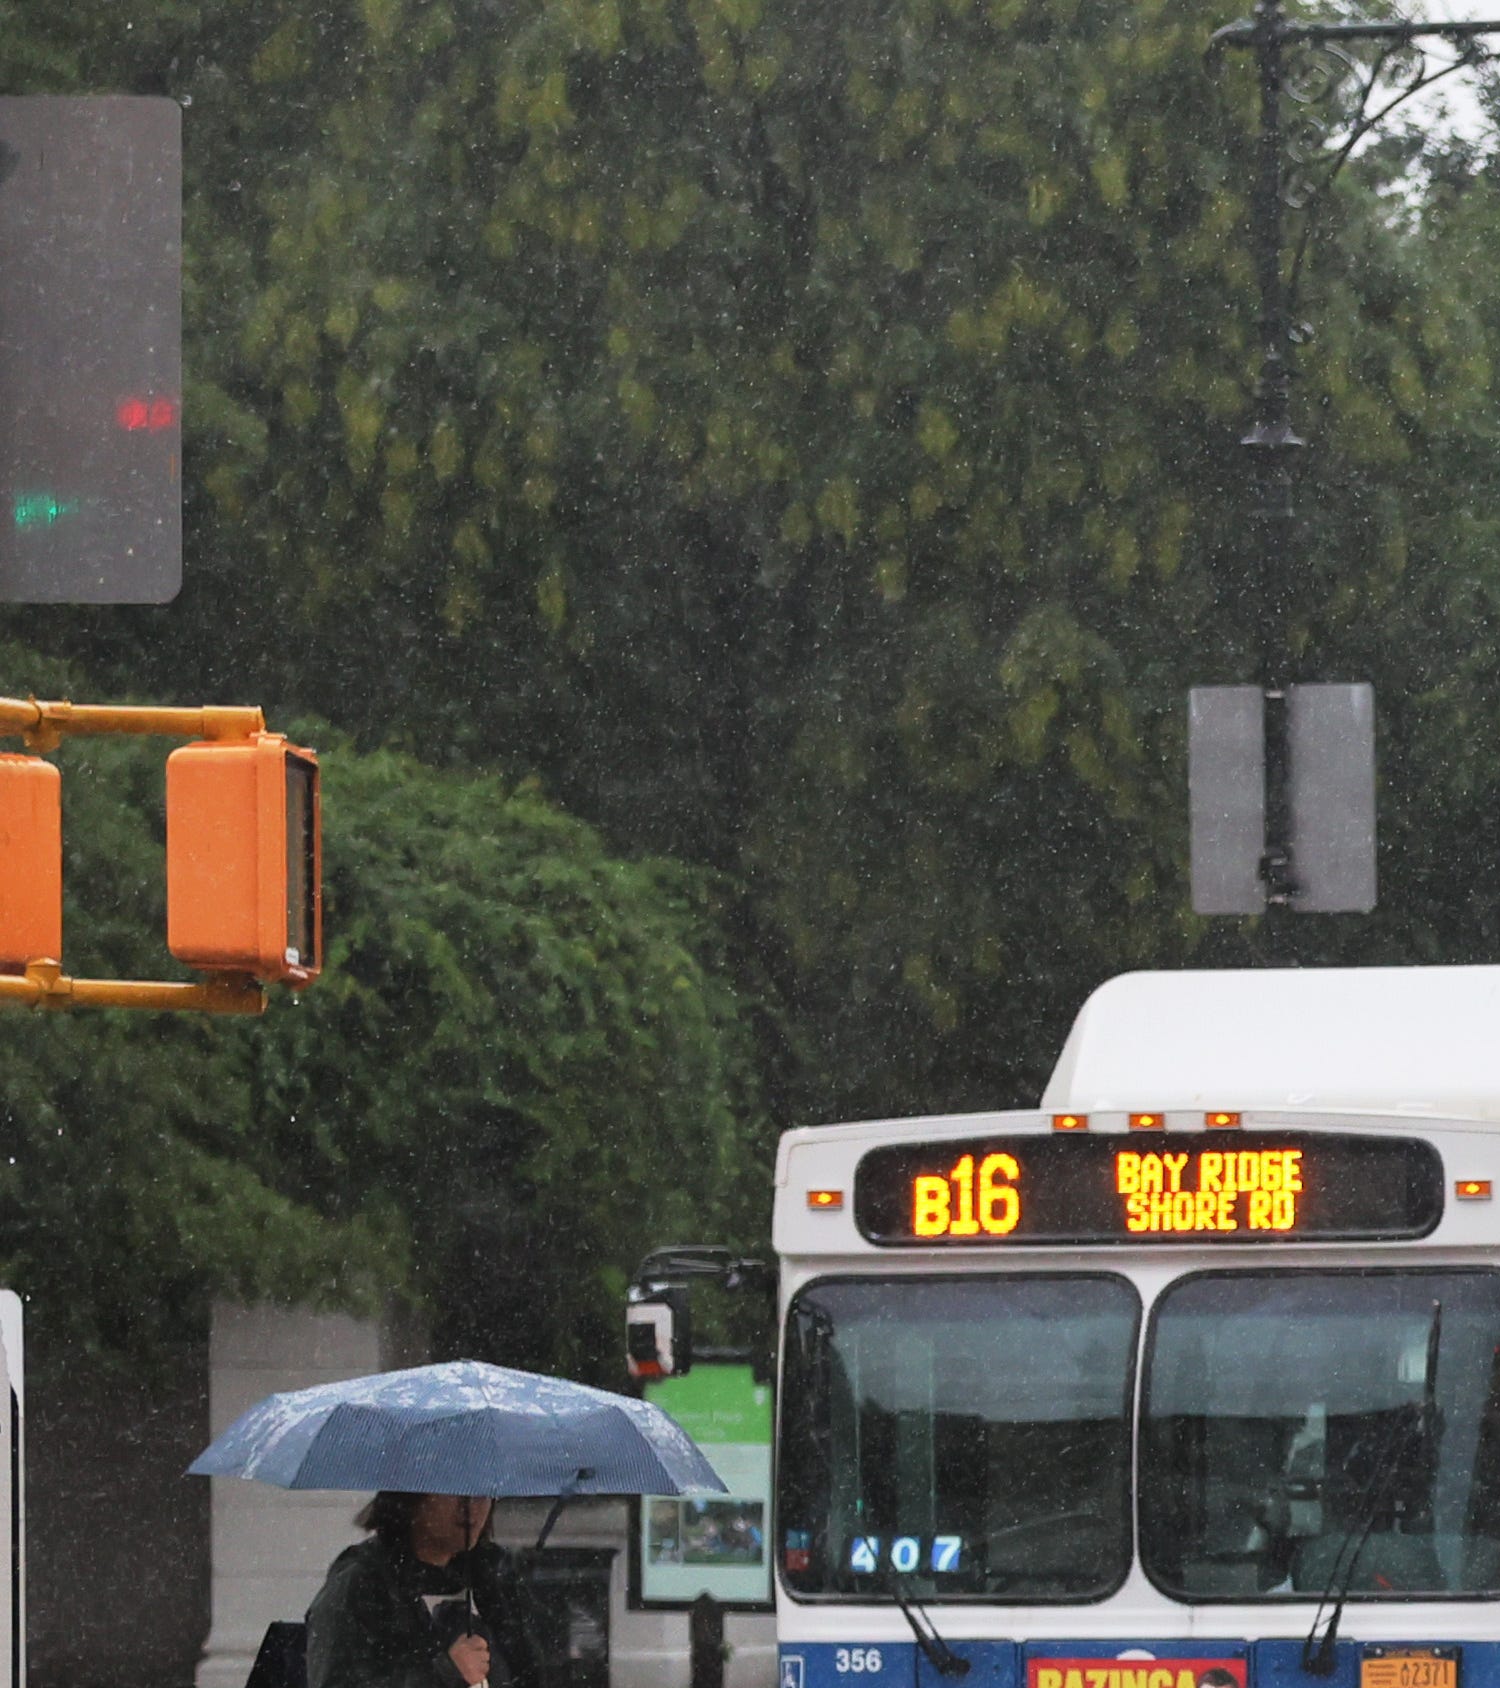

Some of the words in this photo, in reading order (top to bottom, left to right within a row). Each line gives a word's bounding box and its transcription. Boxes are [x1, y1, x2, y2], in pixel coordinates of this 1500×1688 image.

[1116, 1151, 1189, 1193] BAY
[1199, 1151, 1303, 1192] RIDGE
[913, 1153, 1021, 1237] B16
[1126, 1191, 1238, 1232] SHORE
[1249, 1190, 1296, 1231] RD
[851, 1536, 962, 1572] 407
[836, 1648, 882, 1673] 356
